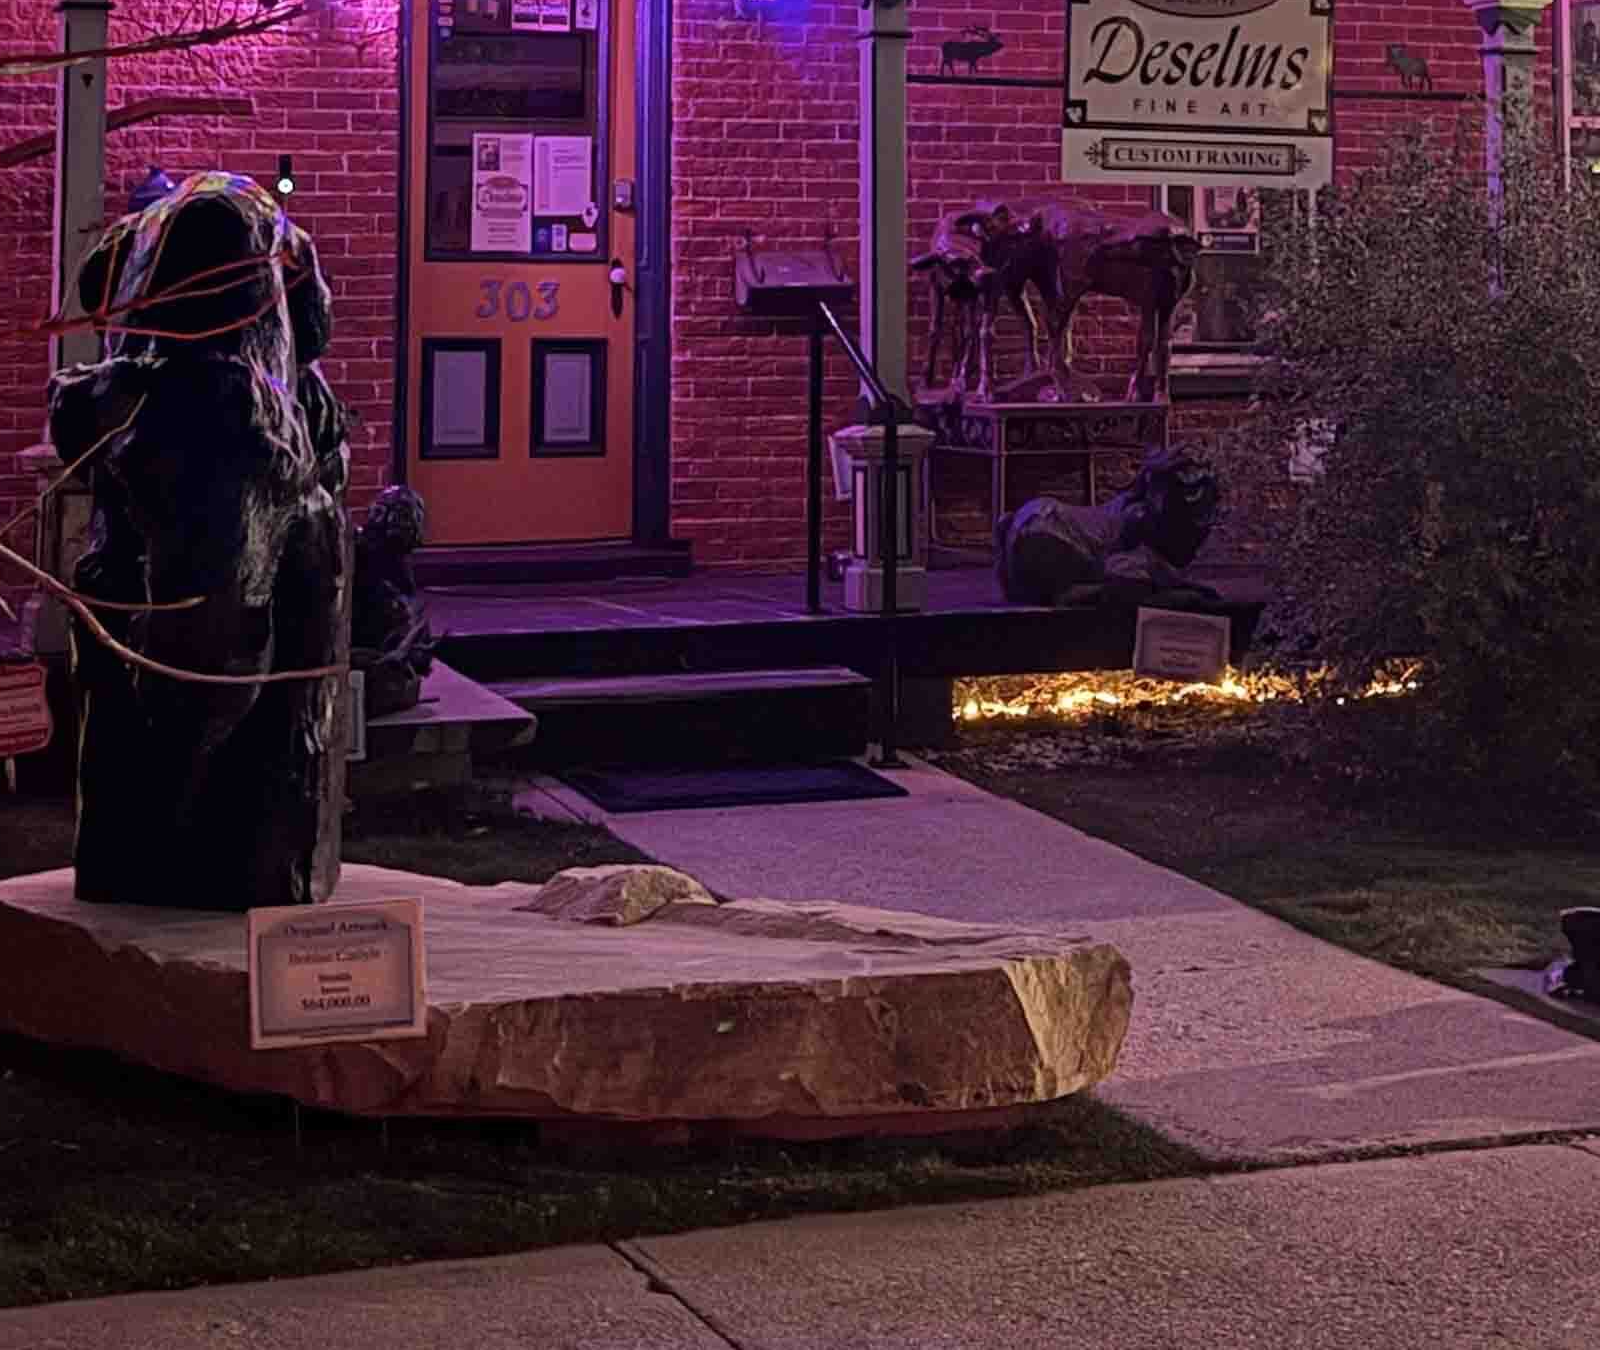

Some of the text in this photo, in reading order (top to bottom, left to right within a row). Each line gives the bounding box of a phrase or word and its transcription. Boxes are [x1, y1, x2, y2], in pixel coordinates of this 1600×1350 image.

[1083, 16, 1309, 91] Deselms
[1133, 98, 1269, 117] FINE ART
[1114, 146, 1282, 167] CUSTOM FRAMING
[474, 279, 561, 322] 303
